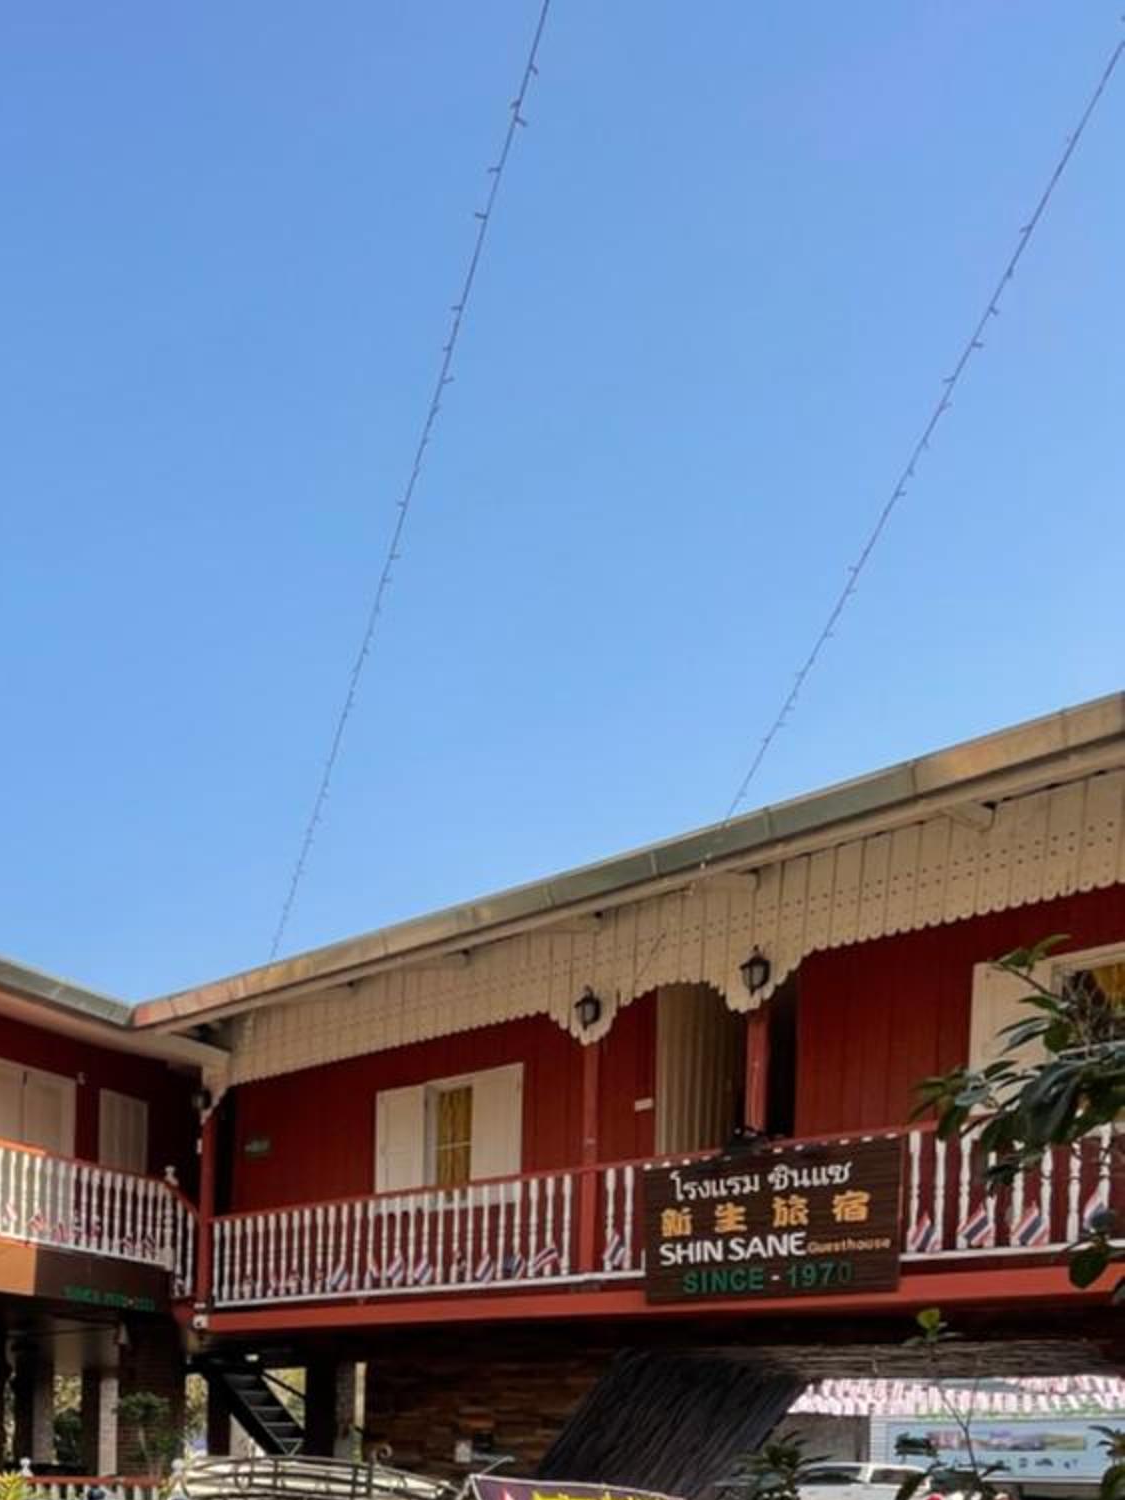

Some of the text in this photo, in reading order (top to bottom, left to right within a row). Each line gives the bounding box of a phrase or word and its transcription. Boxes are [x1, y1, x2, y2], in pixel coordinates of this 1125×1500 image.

[670, 1170, 760, 1201] โรงแรม
[660, 1239, 723, 1266] SHIN
[727, 1231, 806, 1260] SANE
[682, 1267, 764, 1293] SINCE
[786, 1261, 853, 1289] 1970
